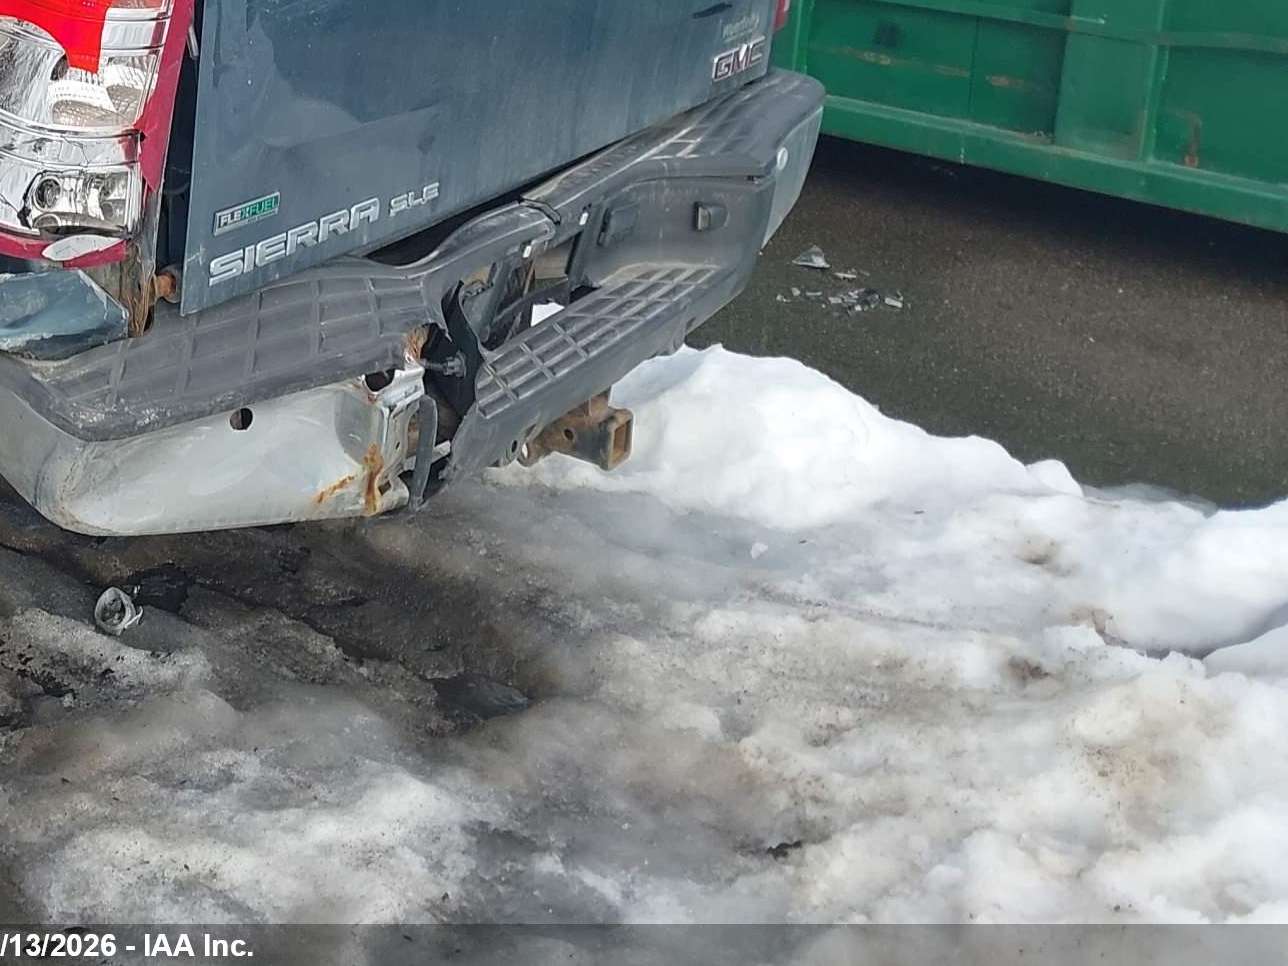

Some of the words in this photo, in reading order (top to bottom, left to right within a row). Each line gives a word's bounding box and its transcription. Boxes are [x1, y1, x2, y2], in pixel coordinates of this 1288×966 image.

[713, 36, 766, 82] GMC
[209, 197, 380, 286] SIERRA
[389, 182, 440, 217] SLE
